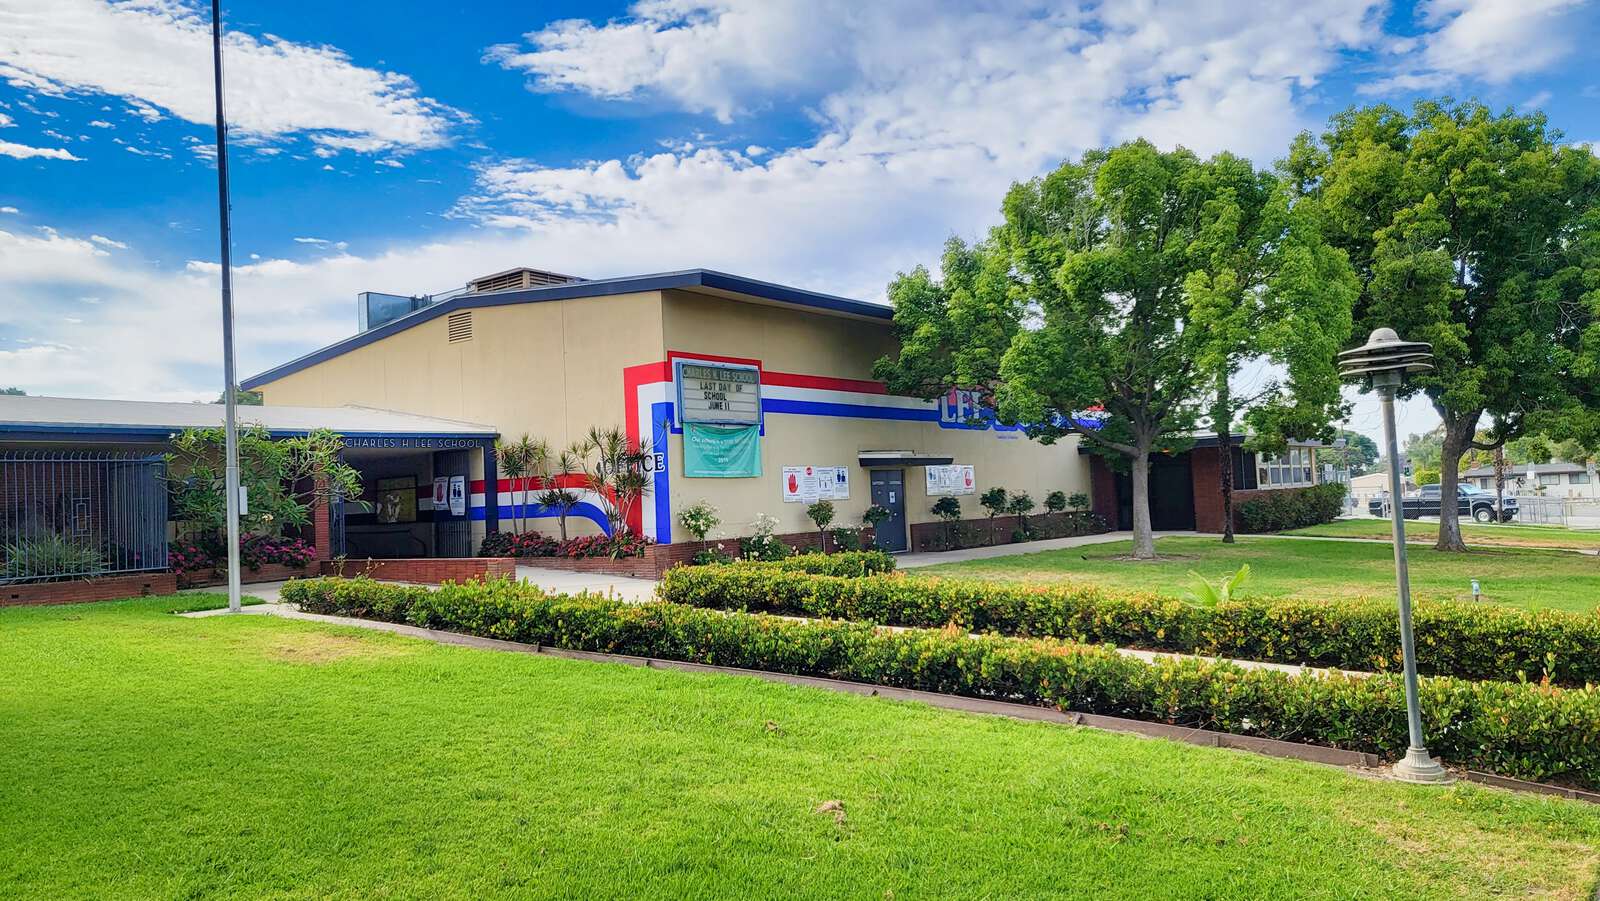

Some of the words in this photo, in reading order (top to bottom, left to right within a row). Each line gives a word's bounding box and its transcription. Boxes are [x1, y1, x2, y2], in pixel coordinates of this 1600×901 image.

[700, 382, 716, 391] LAST
[719, 383, 731, 392] DAY
[736, 384, 743, 393] OF
[704, 391, 728, 401] SCHOOL
[708, 401, 723, 410] JUNE
[724, 402, 730, 411] 11
[345, 438, 396, 448] CHARLES
[402, 439, 409, 448] H
[415, 439, 432, 448] LEE
[438, 439, 482, 448] SCHOOL
